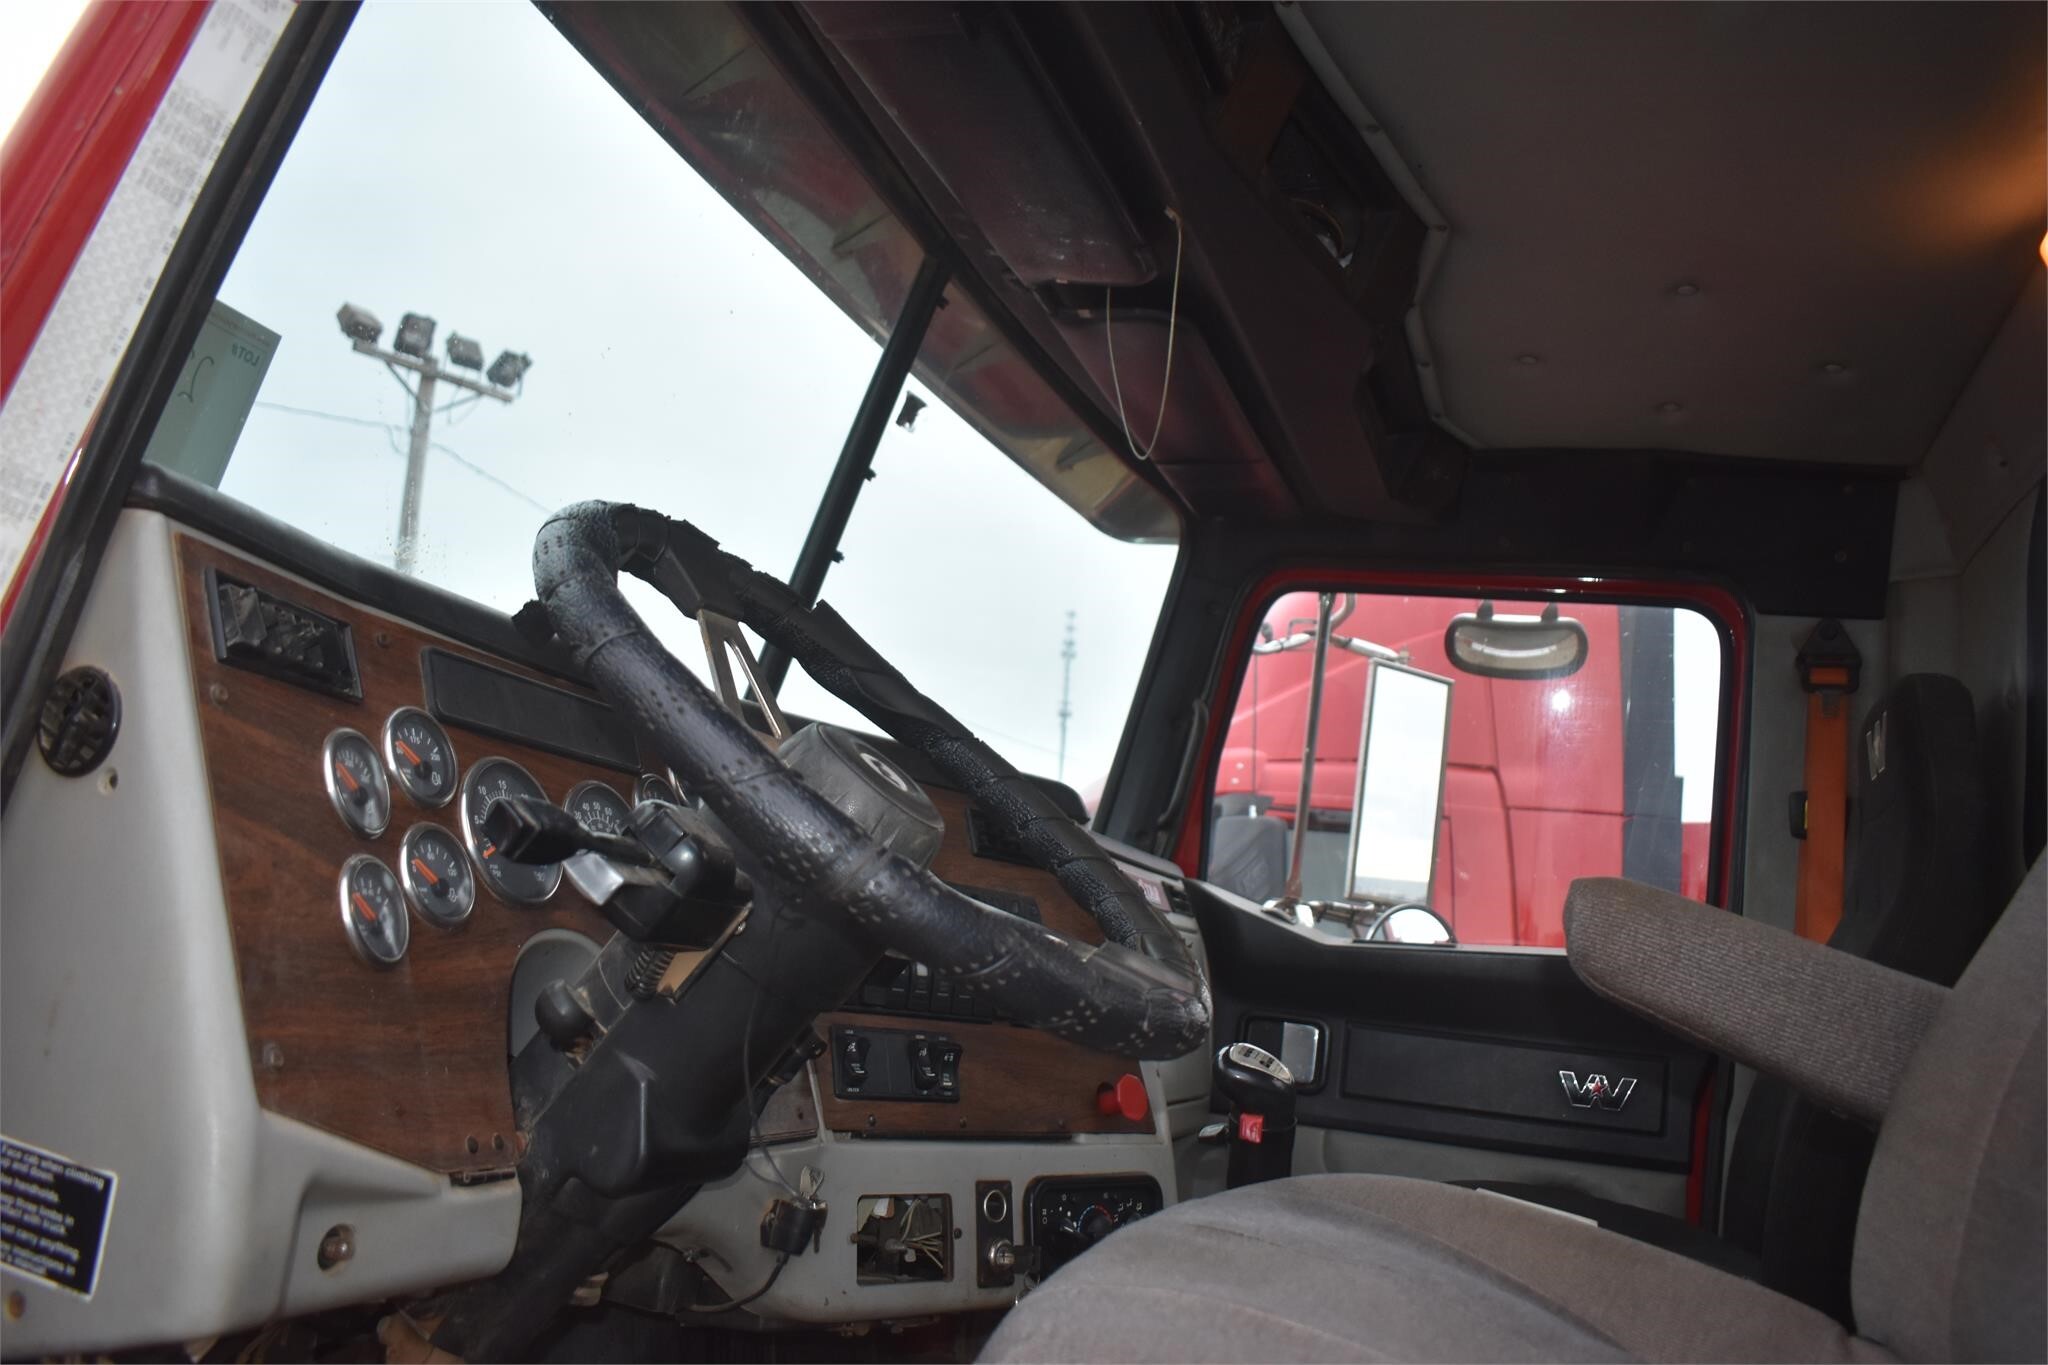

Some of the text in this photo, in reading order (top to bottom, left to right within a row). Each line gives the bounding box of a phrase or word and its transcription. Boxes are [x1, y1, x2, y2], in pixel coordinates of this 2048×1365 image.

[498, 779, 507, 790] 15
[478, 785, 487, 795] 10
[593, 801, 601, 811] 50
[65, 1166, 104, 1190] climbing
